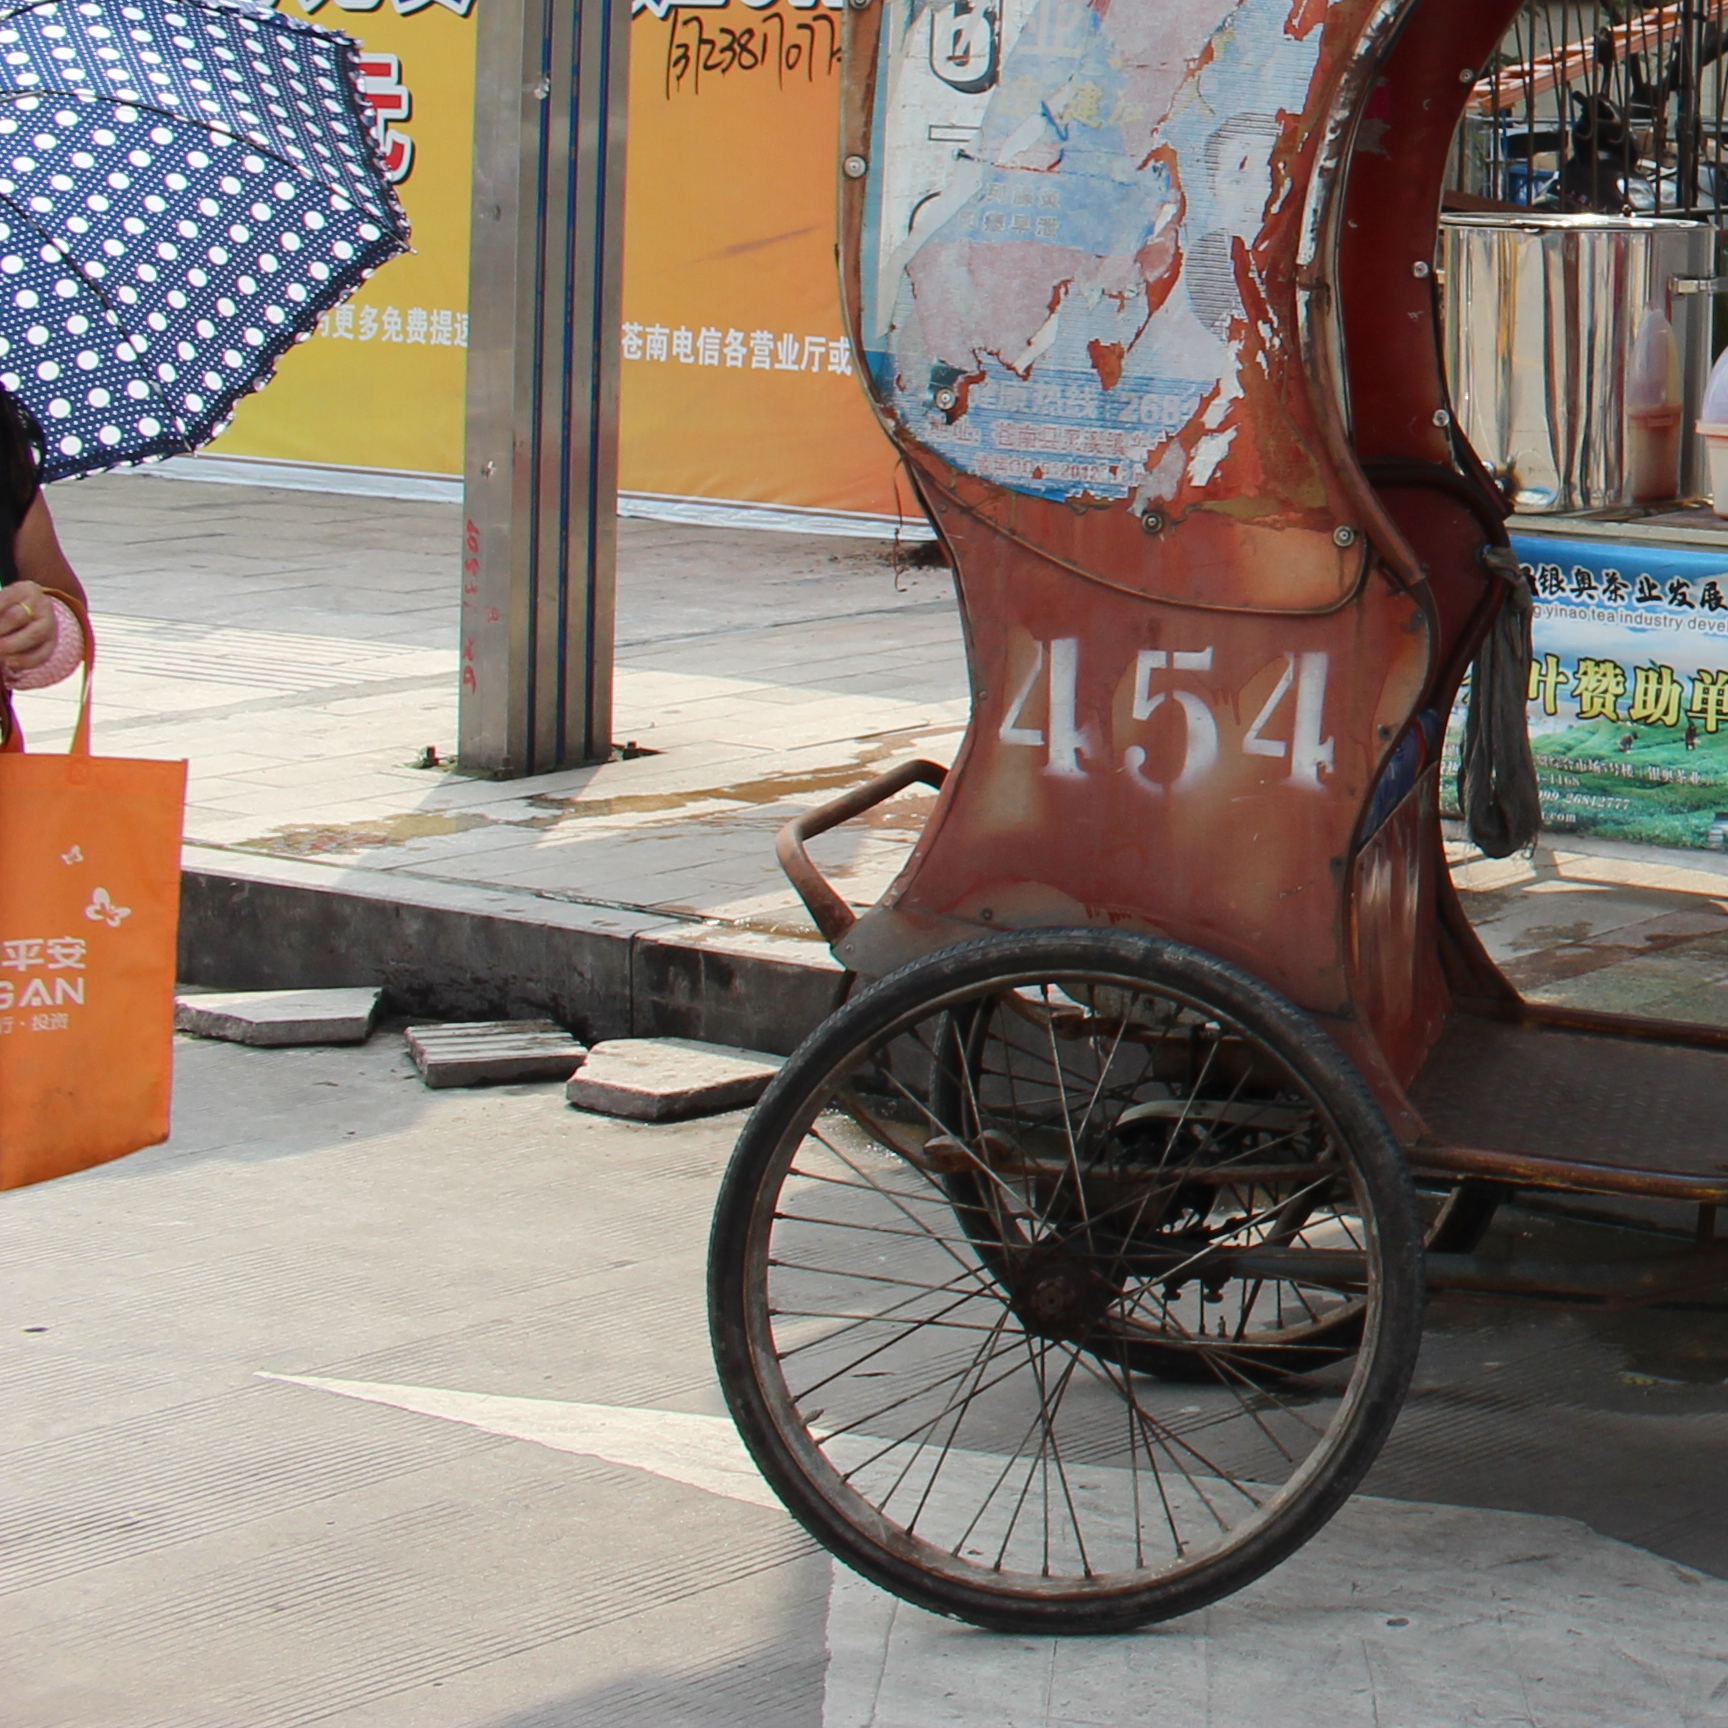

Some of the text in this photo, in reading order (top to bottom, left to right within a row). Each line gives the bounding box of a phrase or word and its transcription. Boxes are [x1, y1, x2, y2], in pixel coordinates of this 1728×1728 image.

[1619, 609, 1685, 633] industry
[997, 635, 1336, 798] 454
[2, 936, 88, 972] 平安
